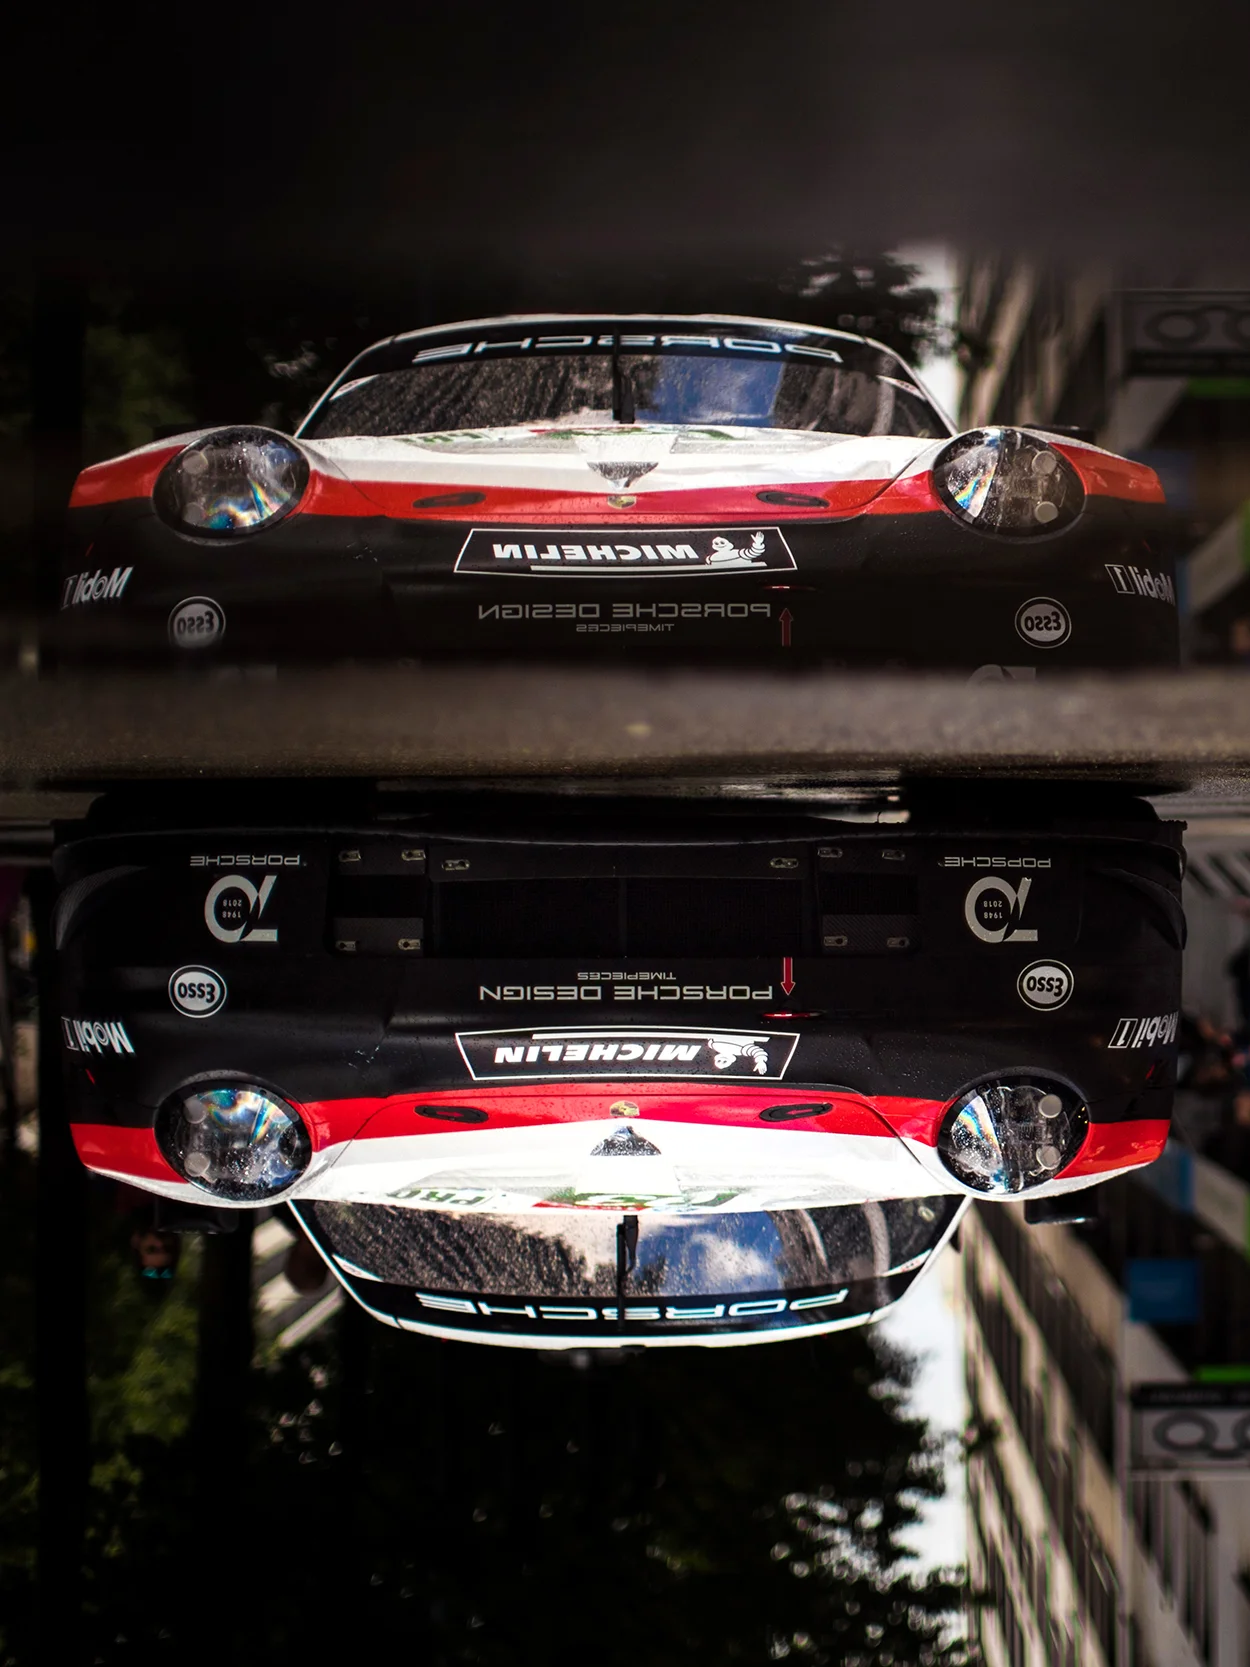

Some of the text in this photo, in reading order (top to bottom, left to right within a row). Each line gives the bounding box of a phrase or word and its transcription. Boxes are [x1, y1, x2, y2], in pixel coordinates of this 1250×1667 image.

[189, 854, 301, 867] PORSCHE
[203, 874, 279, 944] 70
[222, 899, 243, 907] 2018
[964, 876, 1039, 944] 70
[983, 900, 1003, 908] 2018
[221, 910, 242, 918] 1948
[983, 911, 1003, 919] 1948
[577, 972, 676, 980] TIMEPIECES
[177, 982, 216, 1003] Esso
[479, 986, 773, 1000] PORSCHE DESIGN
[1026, 976, 1064, 997] Esso
[71, 1020, 136, 1057] Mobil
[1130, 1011, 1179, 1049] Mobil
[494, 1044, 702, 1064] MICHELIN
[414, 1288, 849, 1321] PORSCHE
